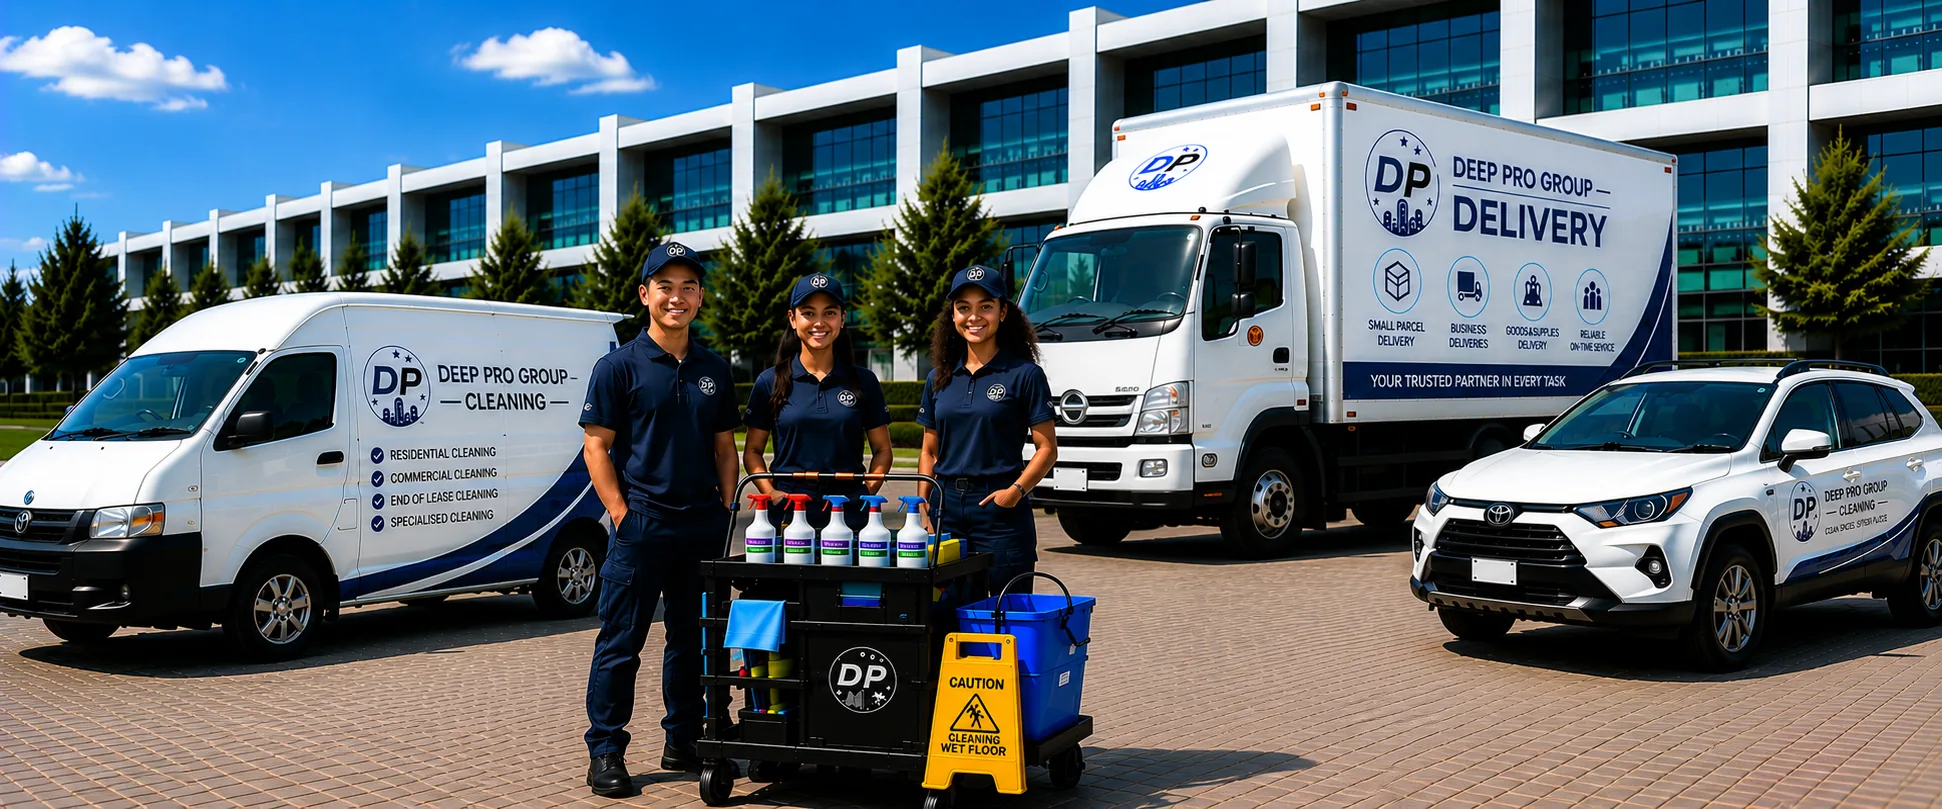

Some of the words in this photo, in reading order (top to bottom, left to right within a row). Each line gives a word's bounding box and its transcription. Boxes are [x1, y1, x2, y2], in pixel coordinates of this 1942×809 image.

[1138, 153, 1200, 175] DP
[1374, 155, 1431, 198] DP
[1453, 156, 1497, 183] DEEP
[1502, 164, 1536, 189] PRO
[1540, 171, 1593, 198] GROUP
[1453, 195, 1607, 248] DELIVERY
[1368, 319, 1395, 331] SMALL
[1396, 321, 1425, 333] PARCEL
[1450, 323, 1487, 335] BUSINESS
[1377, 335, 1415, 347] DELIVERY
[1518, 340, 1547, 350] DELIVERY
[372, 365, 422, 396] DP
[438, 365, 479, 383] DEEP
[484, 366, 514, 384] PRO
[518, 368, 568, 385] GROUP
[1370, 374, 1402, 388] YOUR
[1404, 374, 1453, 388] TRUSTED
[1454, 374, 1499, 387] PARTNER
[1501, 375, 1512, 387] IN
[1514, 375, 1542, 387] EVERY
[1543, 375, 1566, 387] TASK
[465, 392, 546, 411] CLEANING
[390, 449, 450, 461] RESIDENTIAL
[451, 446, 497, 459] CLEANING
[390, 470, 453, 484] COMMERCIAL
[454, 467, 498, 480] CLEANING
[390, 494, 410, 507] END
[412, 493, 424, 505] OF
[426, 491, 455, 504] LEASE
[456, 488, 498, 501] CLEANING
[1824, 487, 1844, 502] DEEP
[1846, 485, 1861, 498] PRO
[1863, 480, 1888, 495] GROUP
[1793, 496, 1816, 521] DP
[1839, 499, 1875, 516] CLEANING
[390, 513, 448, 528] SPECIALISED
[450, 509, 494, 523] CLEANING
[837, 663, 887, 689] DP
[949, 676, 1004, 690] CAUTION
[948, 733, 1000, 745] CLEANING
[941, 743, 965, 754] WET
[968, 744, 1006, 756] FLOOR
